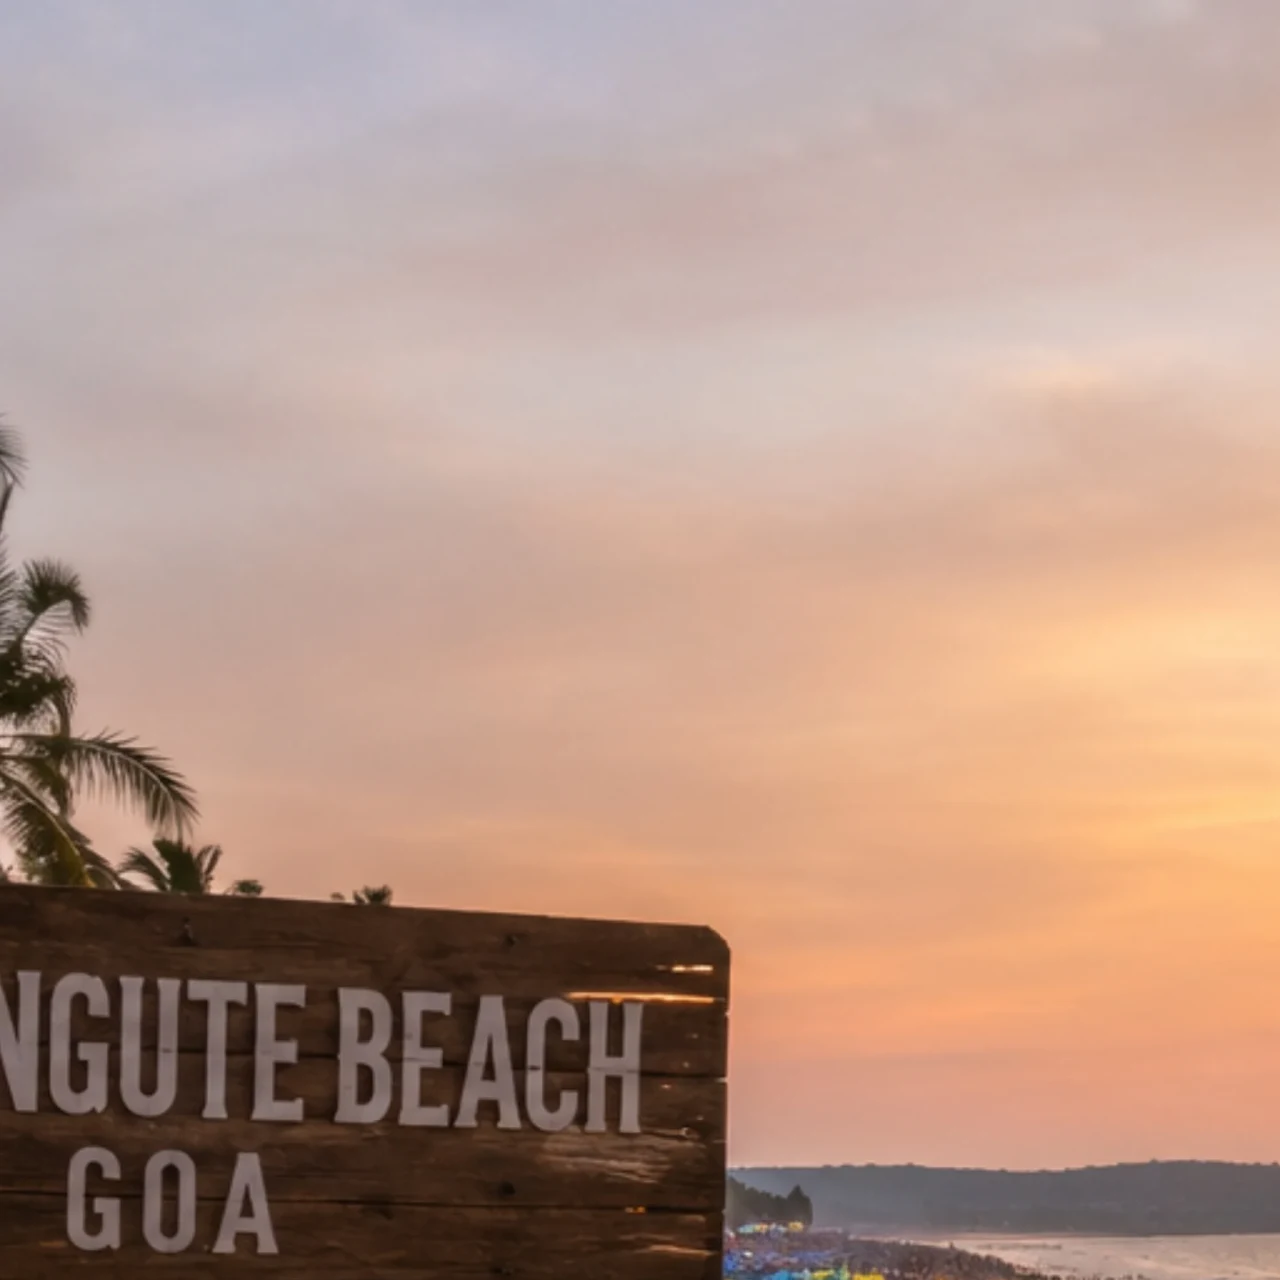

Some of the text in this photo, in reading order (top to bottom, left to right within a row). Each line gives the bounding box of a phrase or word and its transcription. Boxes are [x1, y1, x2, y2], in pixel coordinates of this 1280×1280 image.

[0, 970, 643, 1133] NGUTE BEACH
[67, 1147, 279, 1254] GOA
